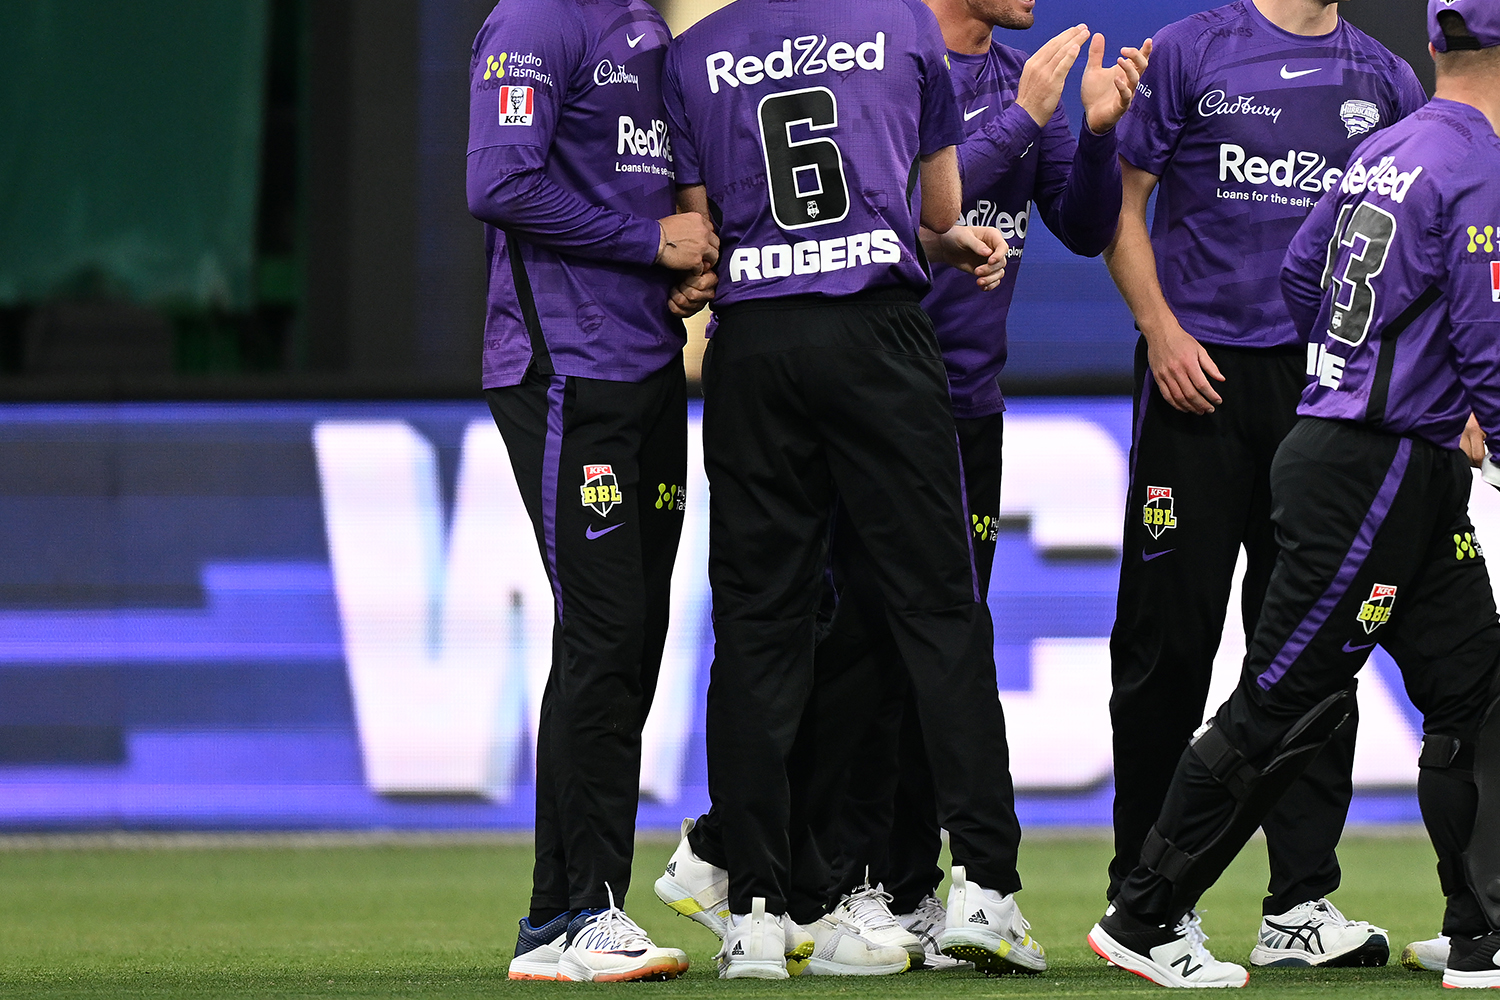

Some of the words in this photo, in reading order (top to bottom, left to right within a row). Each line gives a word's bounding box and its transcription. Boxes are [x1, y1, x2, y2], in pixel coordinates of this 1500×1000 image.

[508, 51, 542, 67] Hydro
[705, 31, 885, 94] RedZed
[508, 65, 554, 87] Tasmani
[593, 59, 639, 91] Cadbury
[1198, 89, 1282, 123] Cadbury
[504, 115, 527, 124] KFC
[616, 161, 642, 174] Loans
[757, 86, 850, 230] 6
[1219, 143, 1343, 194] RedZe
[1216, 187, 1249, 201] Loans
[1252, 190, 1268, 202] for
[1271, 193, 1288, 205] the
[729, 229, 901, 283] ROGERS
[589, 466, 608, 475] KFC
[582, 485, 621, 504] BBL
[1150, 487, 1168, 497] KFC
[1144, 506, 1175, 526] BBL
[1375, 585, 1393, 596] KFC
[1359, 603, 1391, 622] BBL
